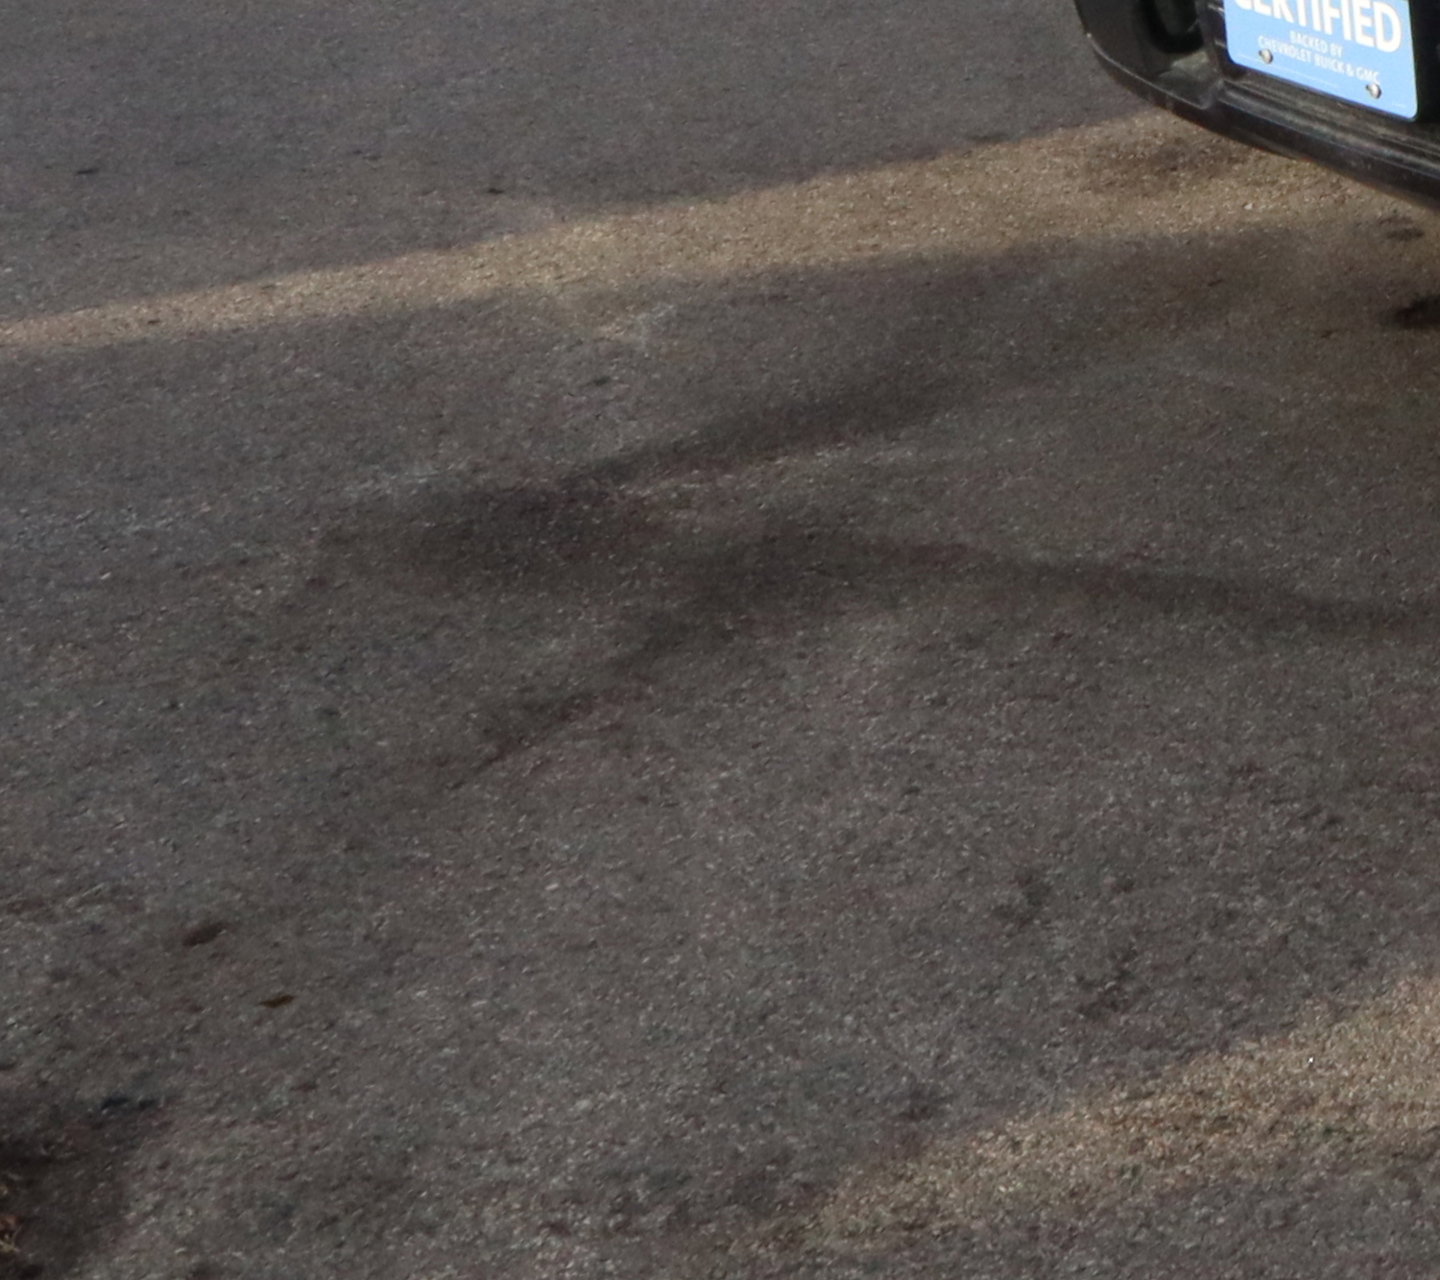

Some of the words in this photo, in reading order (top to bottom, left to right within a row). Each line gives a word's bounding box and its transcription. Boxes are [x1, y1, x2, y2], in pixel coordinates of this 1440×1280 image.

[1257, 35, 1313, 65] CHEVROLET
[1314, 53, 1346, 75] BUICK
[1356, 66, 1381, 85] GMC
[1289, 31, 1330, 55] BACKED
[1330, 42, 1343, 59] BY
